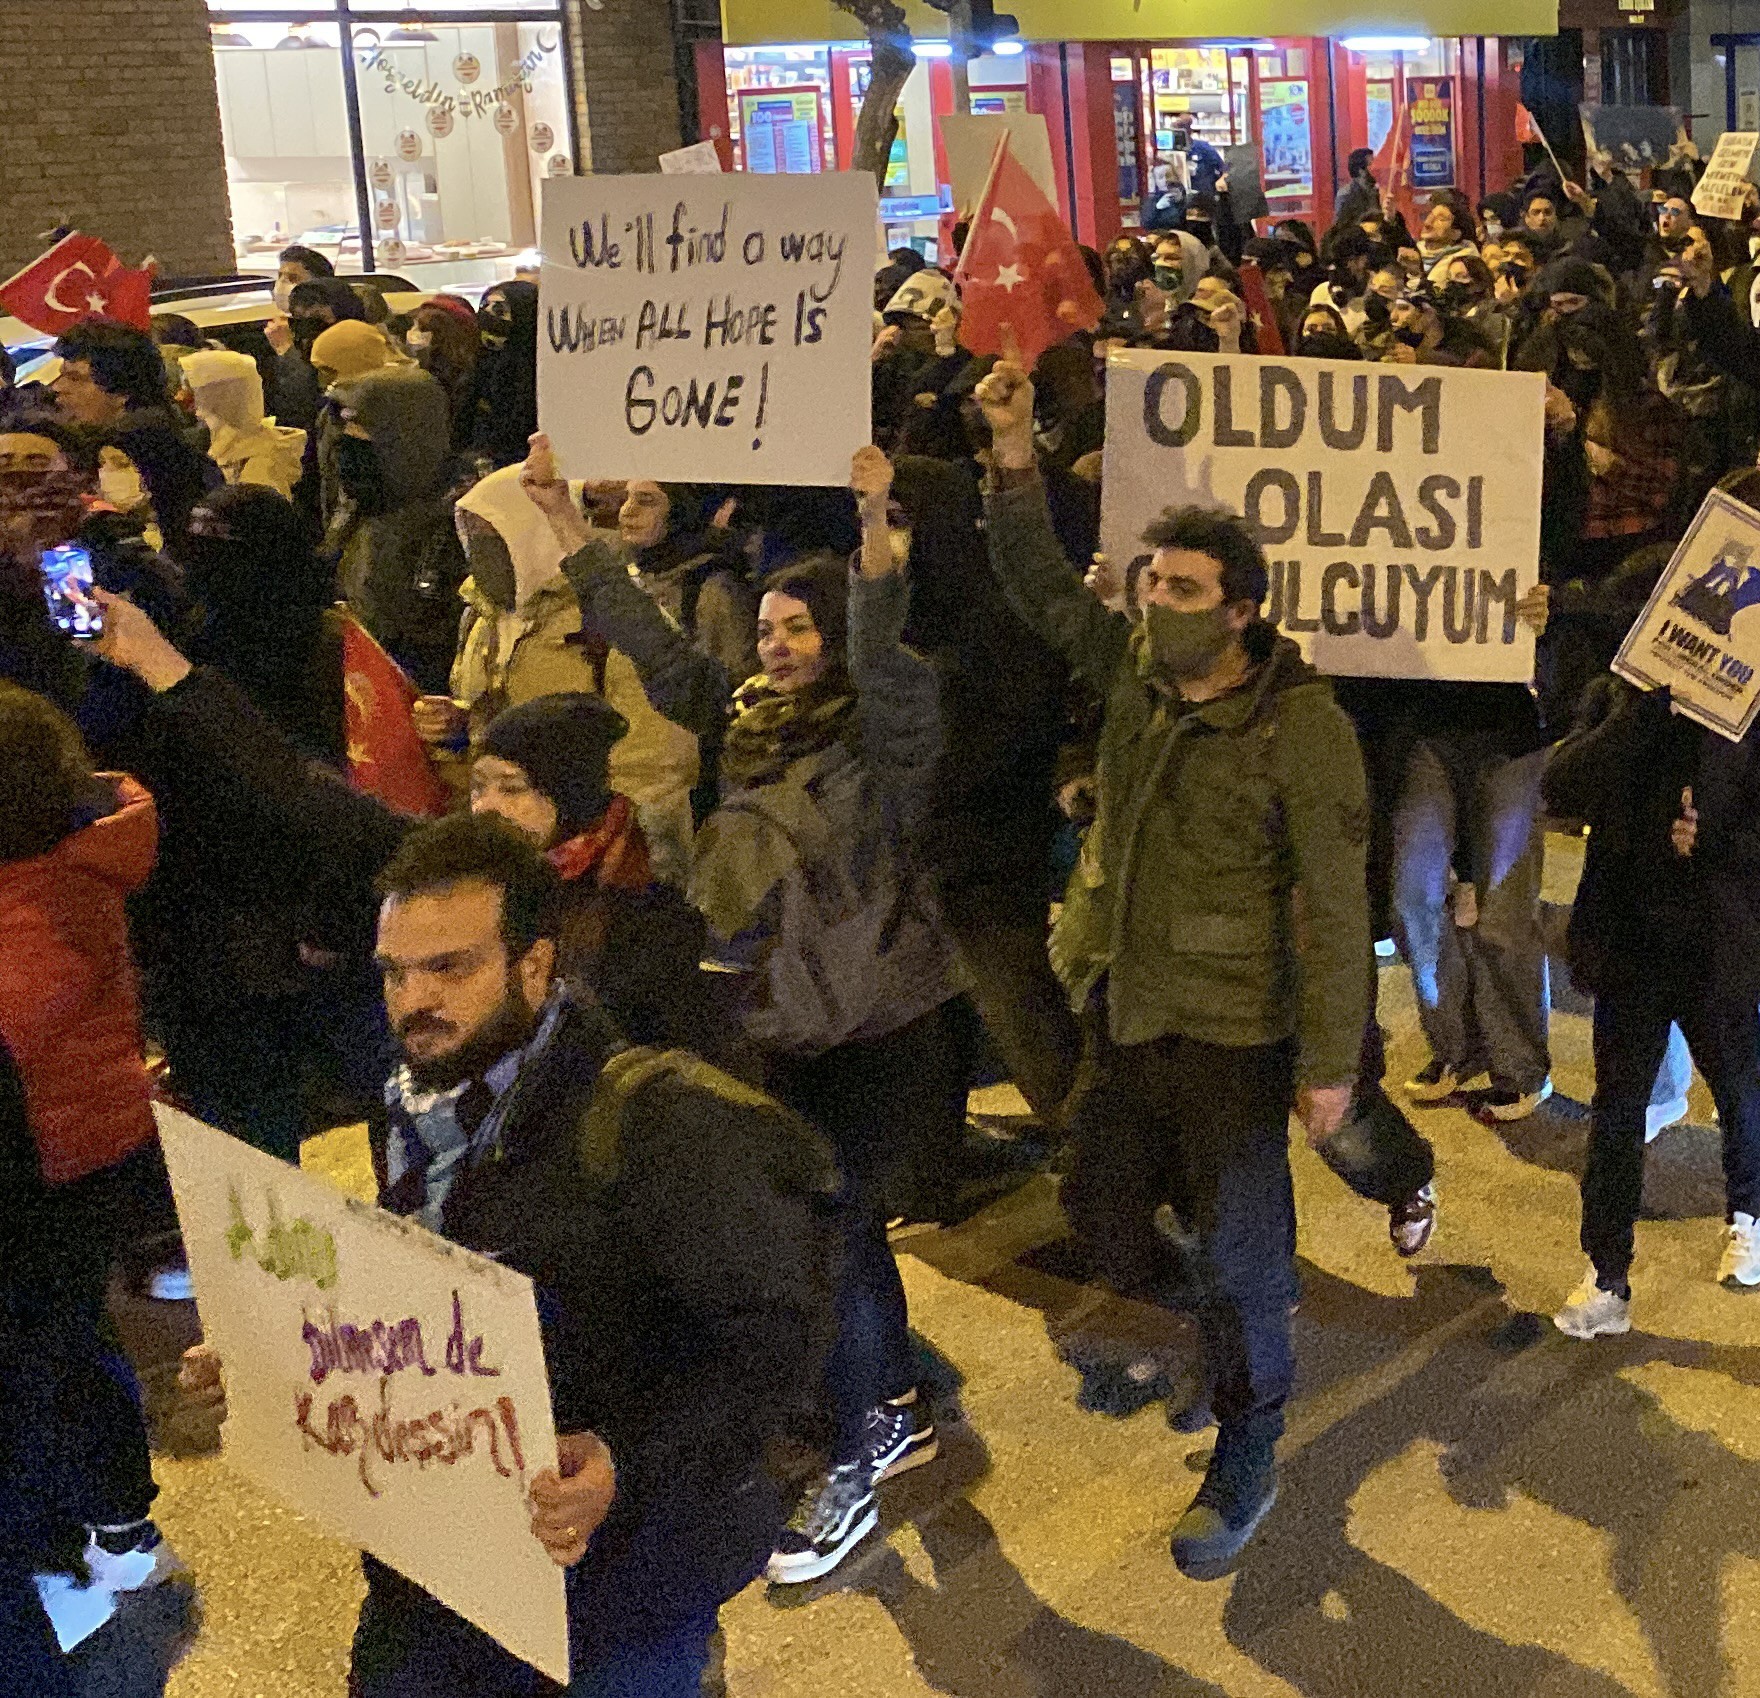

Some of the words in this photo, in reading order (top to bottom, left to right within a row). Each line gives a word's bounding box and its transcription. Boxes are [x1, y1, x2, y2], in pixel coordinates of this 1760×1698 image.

[569, 213, 655, 273] We'll
[665, 201, 732, 273] find
[780, 230, 848, 303] way
[547, 303, 627, 354] WHEN
[635, 299, 692, 350] ALL
[704, 293, 778, 349] HOPE
[1143, 361, 1443, 455] OLDUM
[1243, 468, 1484, 551] OLASI
[1658, 619, 1671, 637] I
[1668, 623, 1721, 664] WANT
[1719, 652, 1754, 686] YOU
[446, 1289, 501, 1377] de
